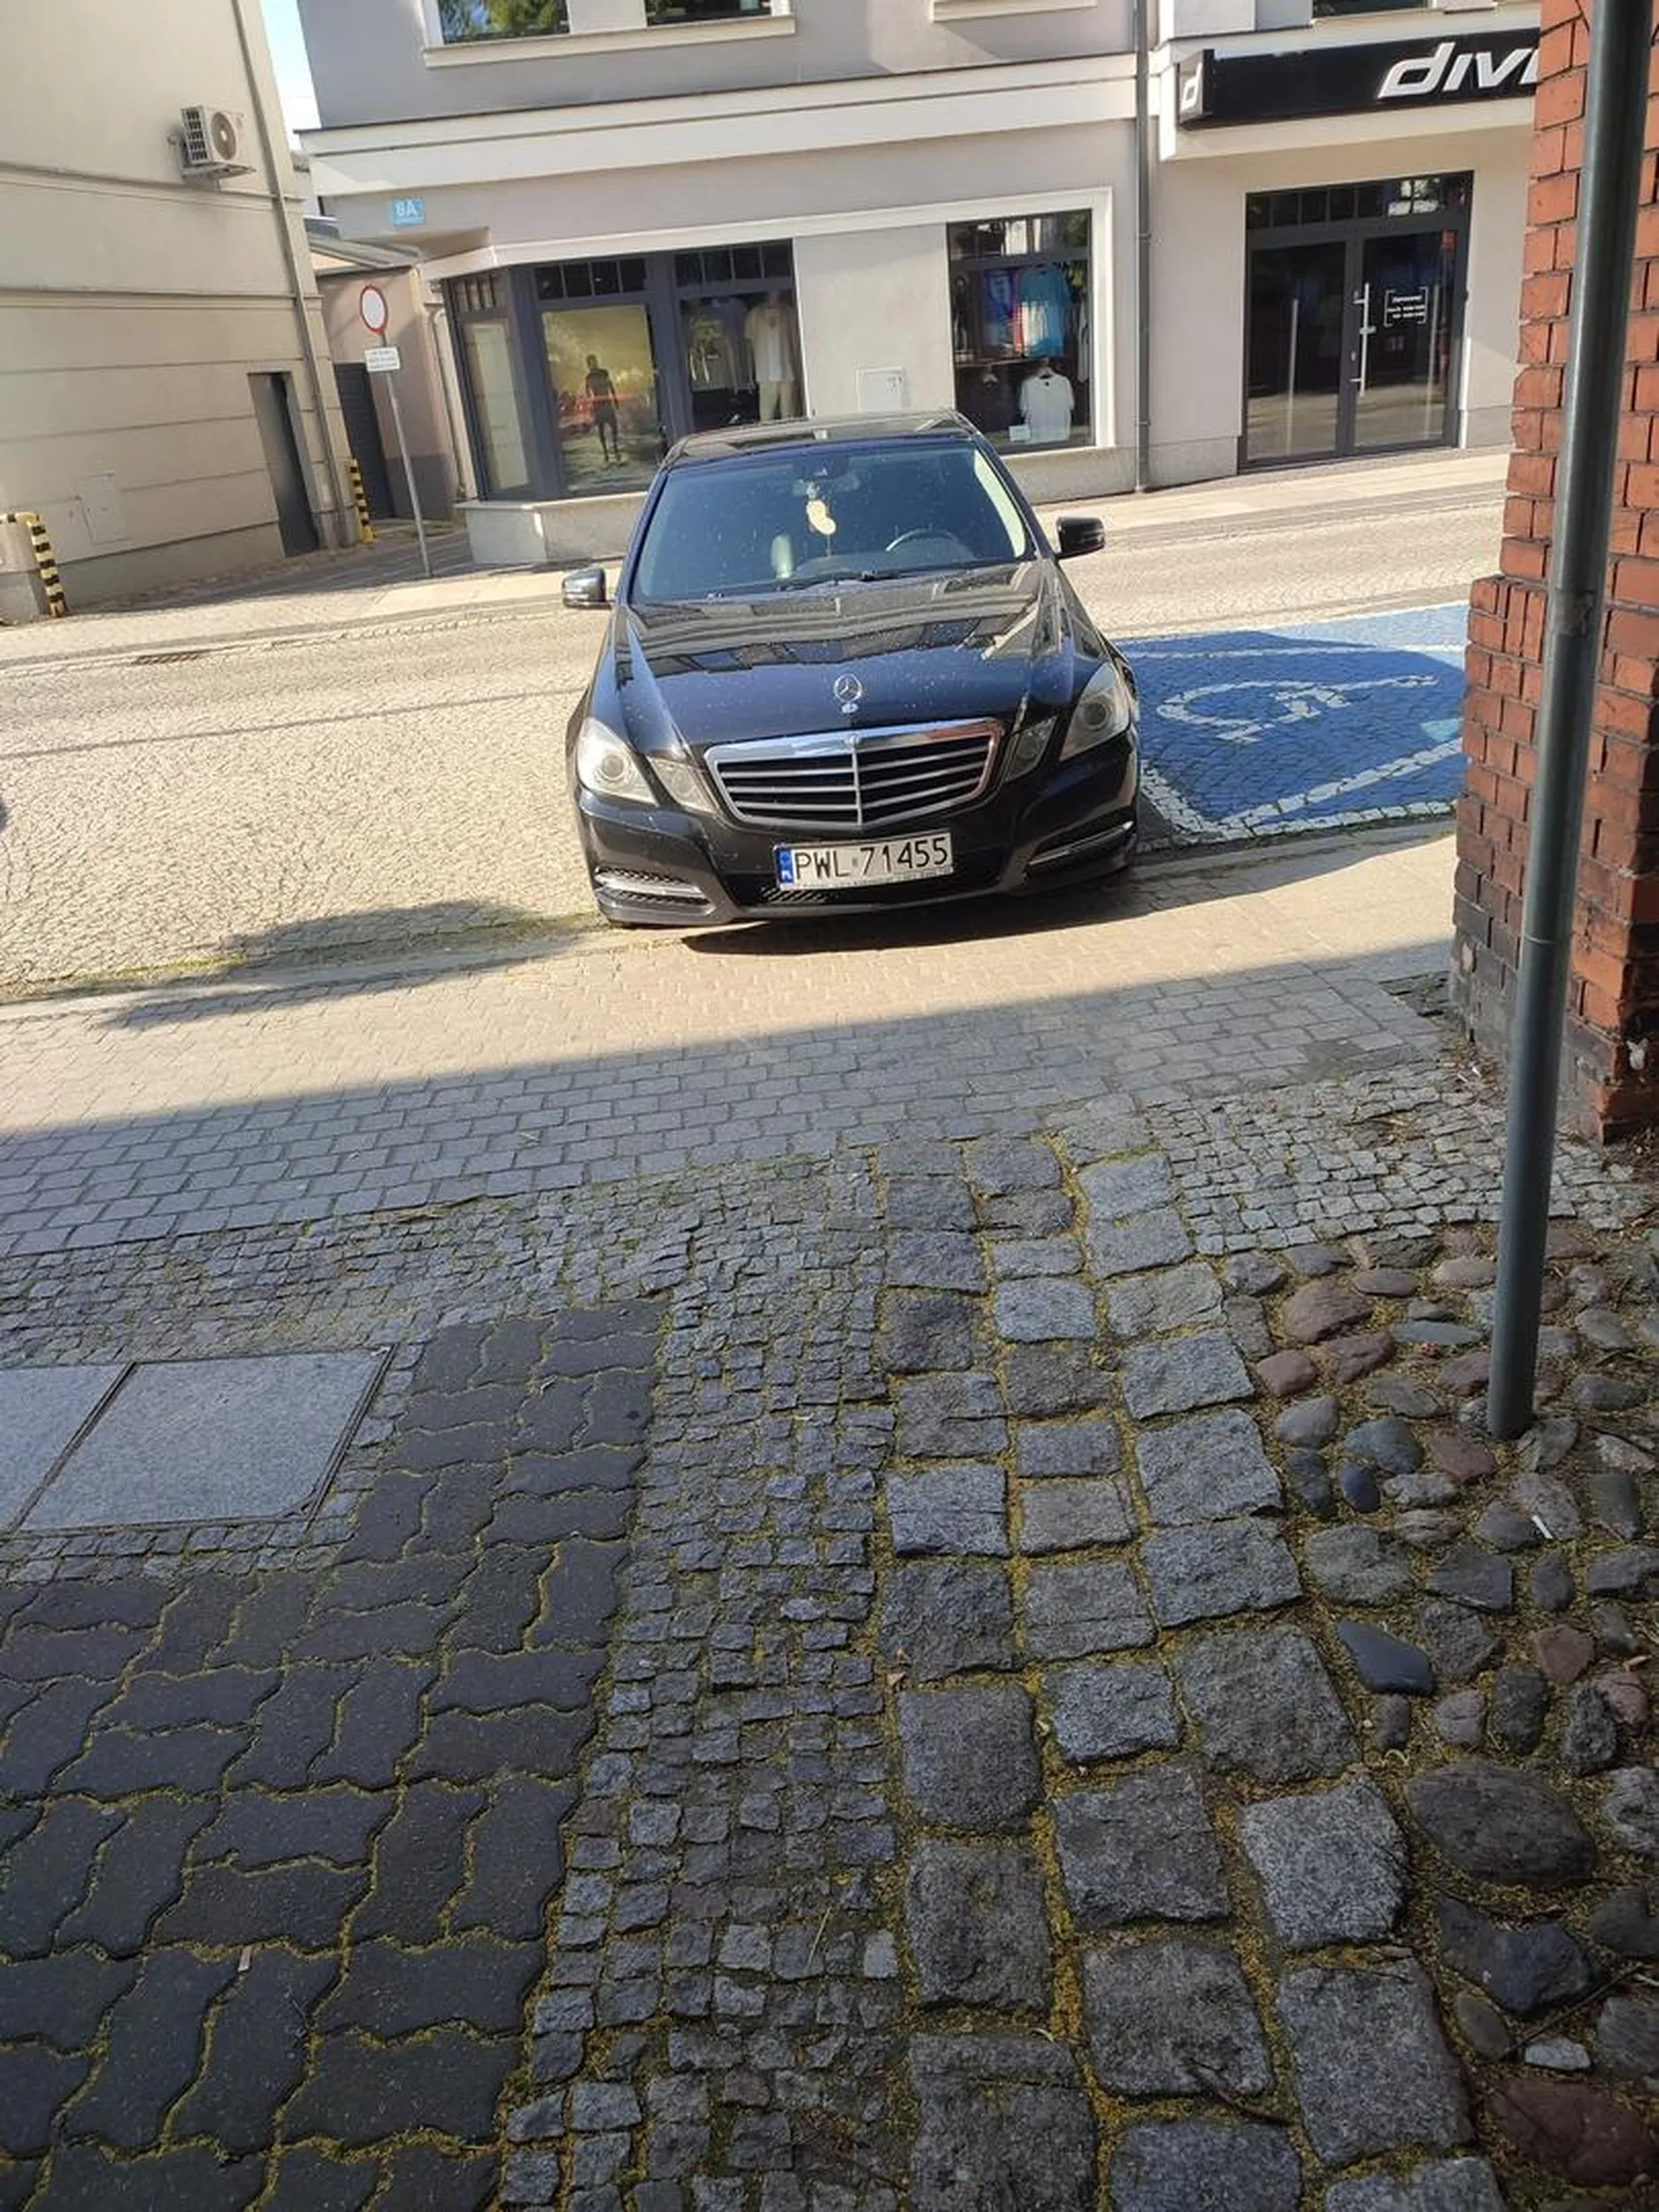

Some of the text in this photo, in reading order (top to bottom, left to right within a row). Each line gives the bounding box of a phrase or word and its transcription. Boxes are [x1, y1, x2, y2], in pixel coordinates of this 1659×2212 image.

[1180, 63, 1202, 111] d
[795, 837, 949, 880] PWL 71455
